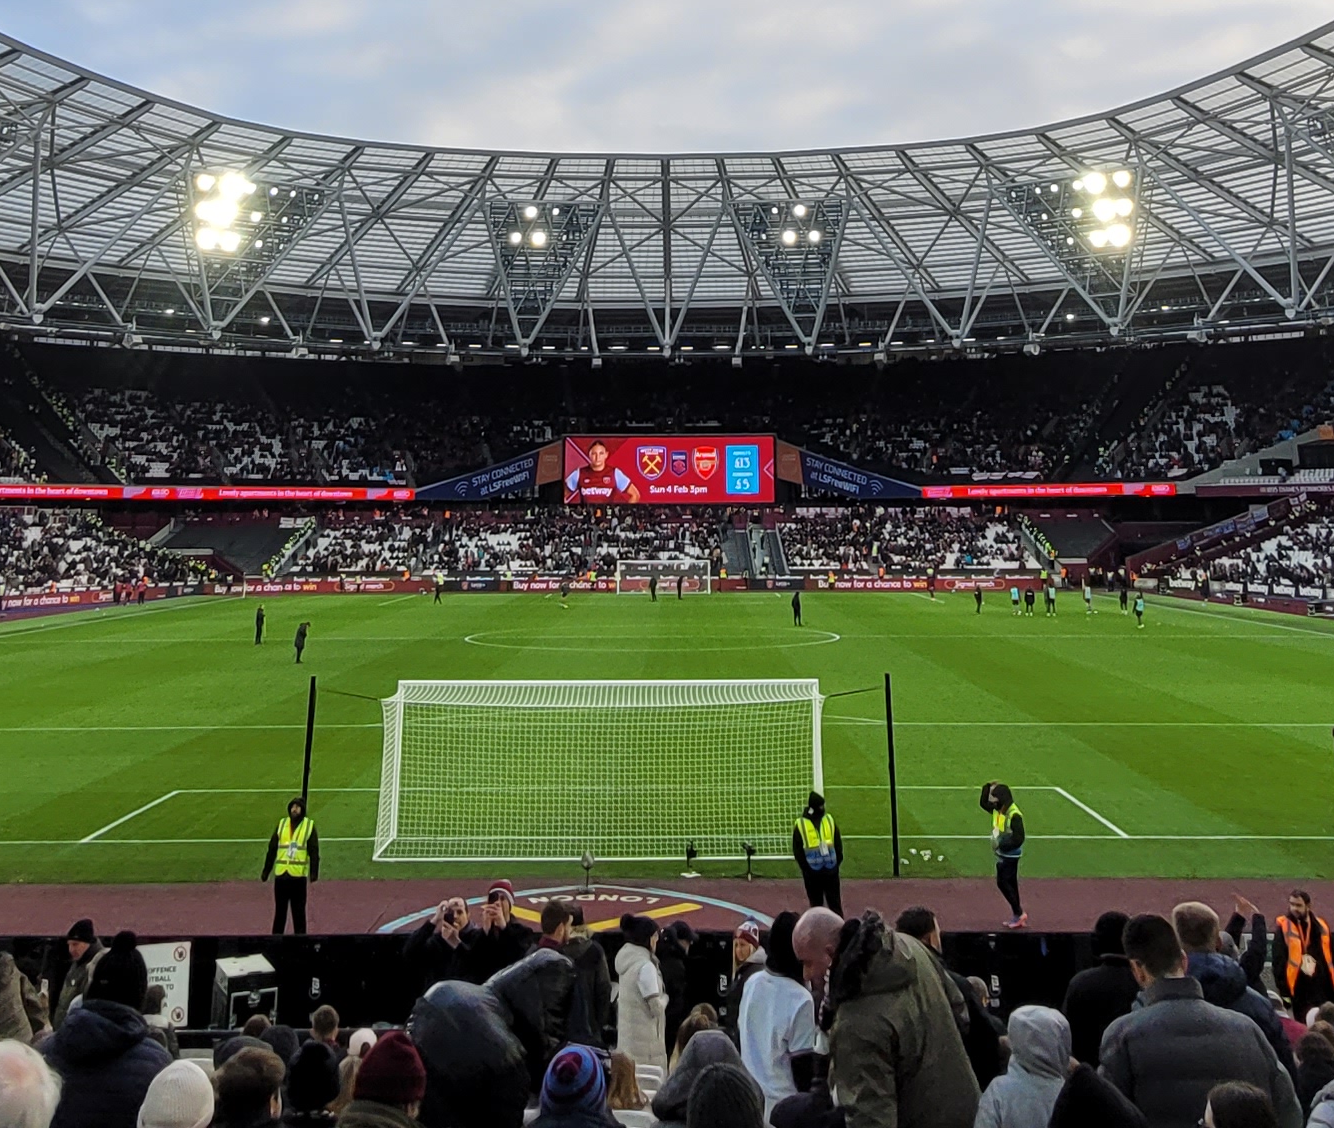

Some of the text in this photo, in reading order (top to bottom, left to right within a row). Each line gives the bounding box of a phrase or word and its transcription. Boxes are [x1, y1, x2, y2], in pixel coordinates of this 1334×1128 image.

[471, 472, 490, 487] STAY
[491, 457, 534, 480] CONNECTED
[805, 456, 867, 485] STAY CONNECTED
[27, 486, 34, 495] in
[34, 486, 46, 495] the
[47, 486, 65, 496] heart
[65, 486, 74, 495] of
[73, 487, 109, 496] downtown
[218, 489, 239, 498] Lovely
[284, 489, 296, 497] the
[295, 489, 313, 498] heart
[320, 490, 354, 498] downtown
[479, 485, 489, 496] at
[580, 486, 613, 498] betway
[649, 484, 708, 496] Sun 4 Feb 3pm
[967, 487, 989, 497] Lovely
[214, 584, 228, 595] Buy
[302, 582, 318, 591] win
[512, 580, 560, 591] Buy now for
[598, 580, 607, 589] to
[835, 580, 852, 589] now
[852, 579, 865, 589] for
[873, 579, 901, 589] chance
[903, 579, 912, 589] to
[913, 579, 928, 589] win
[8, 596, 22, 608] now
[22, 595, 33, 607] for
[39, 594, 62, 606] chance
[62, 594, 69, 604] to
[69, 594, 80, 604] win
[527, 894, 661, 905] LONDON
